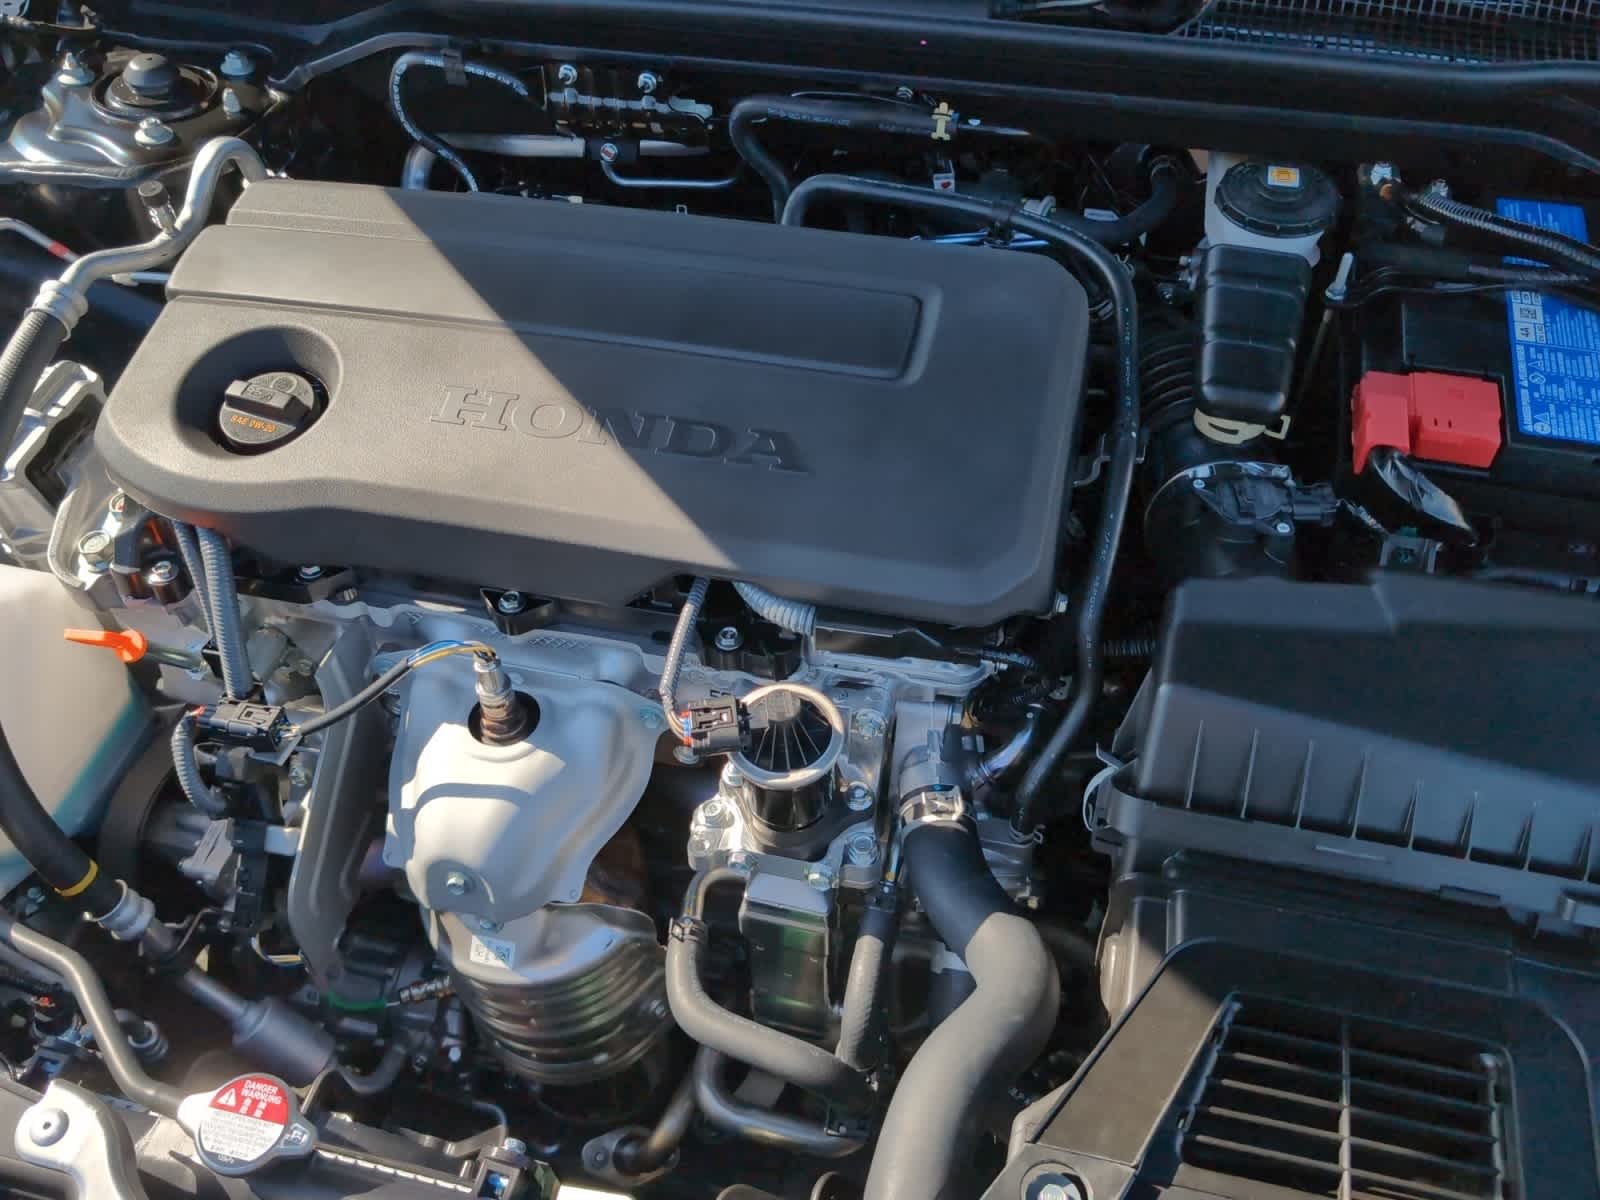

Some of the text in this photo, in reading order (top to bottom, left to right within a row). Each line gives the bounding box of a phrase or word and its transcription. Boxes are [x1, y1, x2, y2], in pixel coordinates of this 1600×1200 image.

[430, 384, 808, 472] HONDA
[241, 1087, 283, 1105] WARNING
[244, 1079, 279, 1095] DANGER
